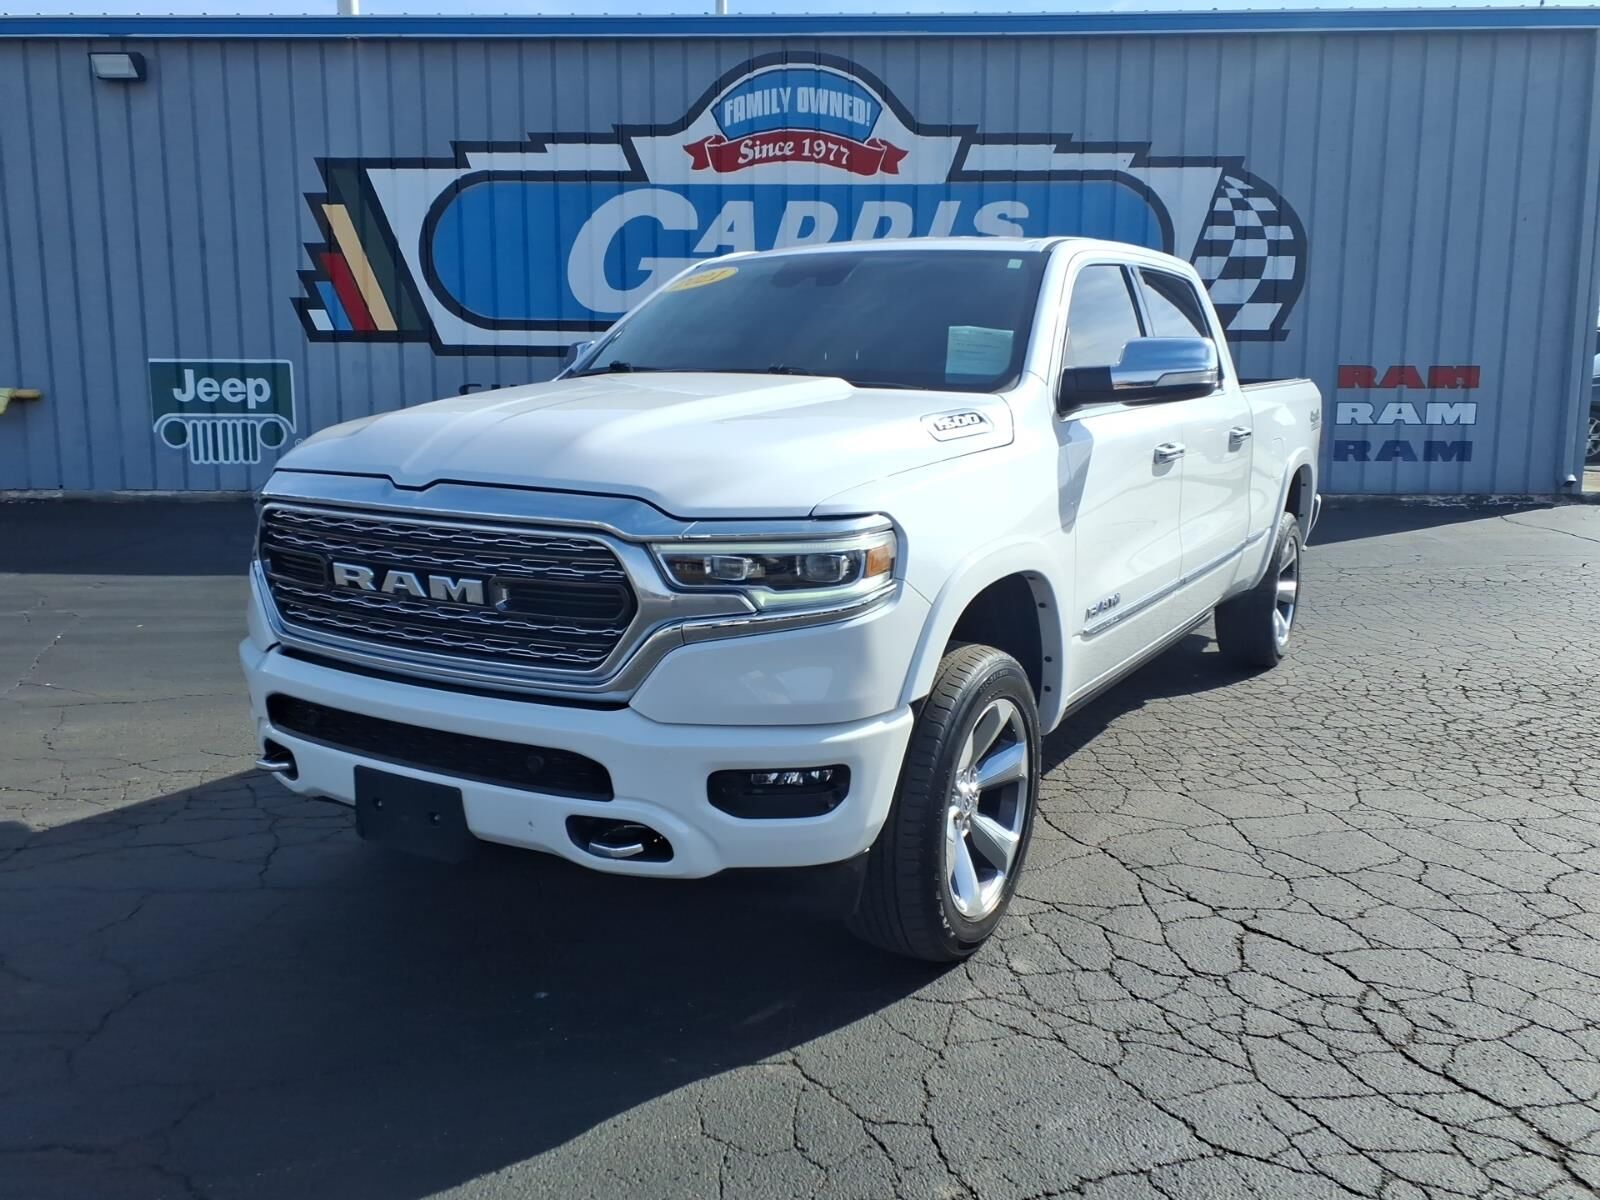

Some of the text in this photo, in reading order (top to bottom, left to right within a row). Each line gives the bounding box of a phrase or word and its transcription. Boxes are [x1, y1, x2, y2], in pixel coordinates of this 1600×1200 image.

[724, 87, 872, 127] FAMILY OWNED!
[737, 138, 850, 165] Since 1977
[172, 368, 271, 409] Jeep
[1337, 364, 1481, 389] RAM
[1335, 401, 1478, 425] RAM
[1333, 439, 1473, 463] RAM
[332, 562, 484, 606] RAM
